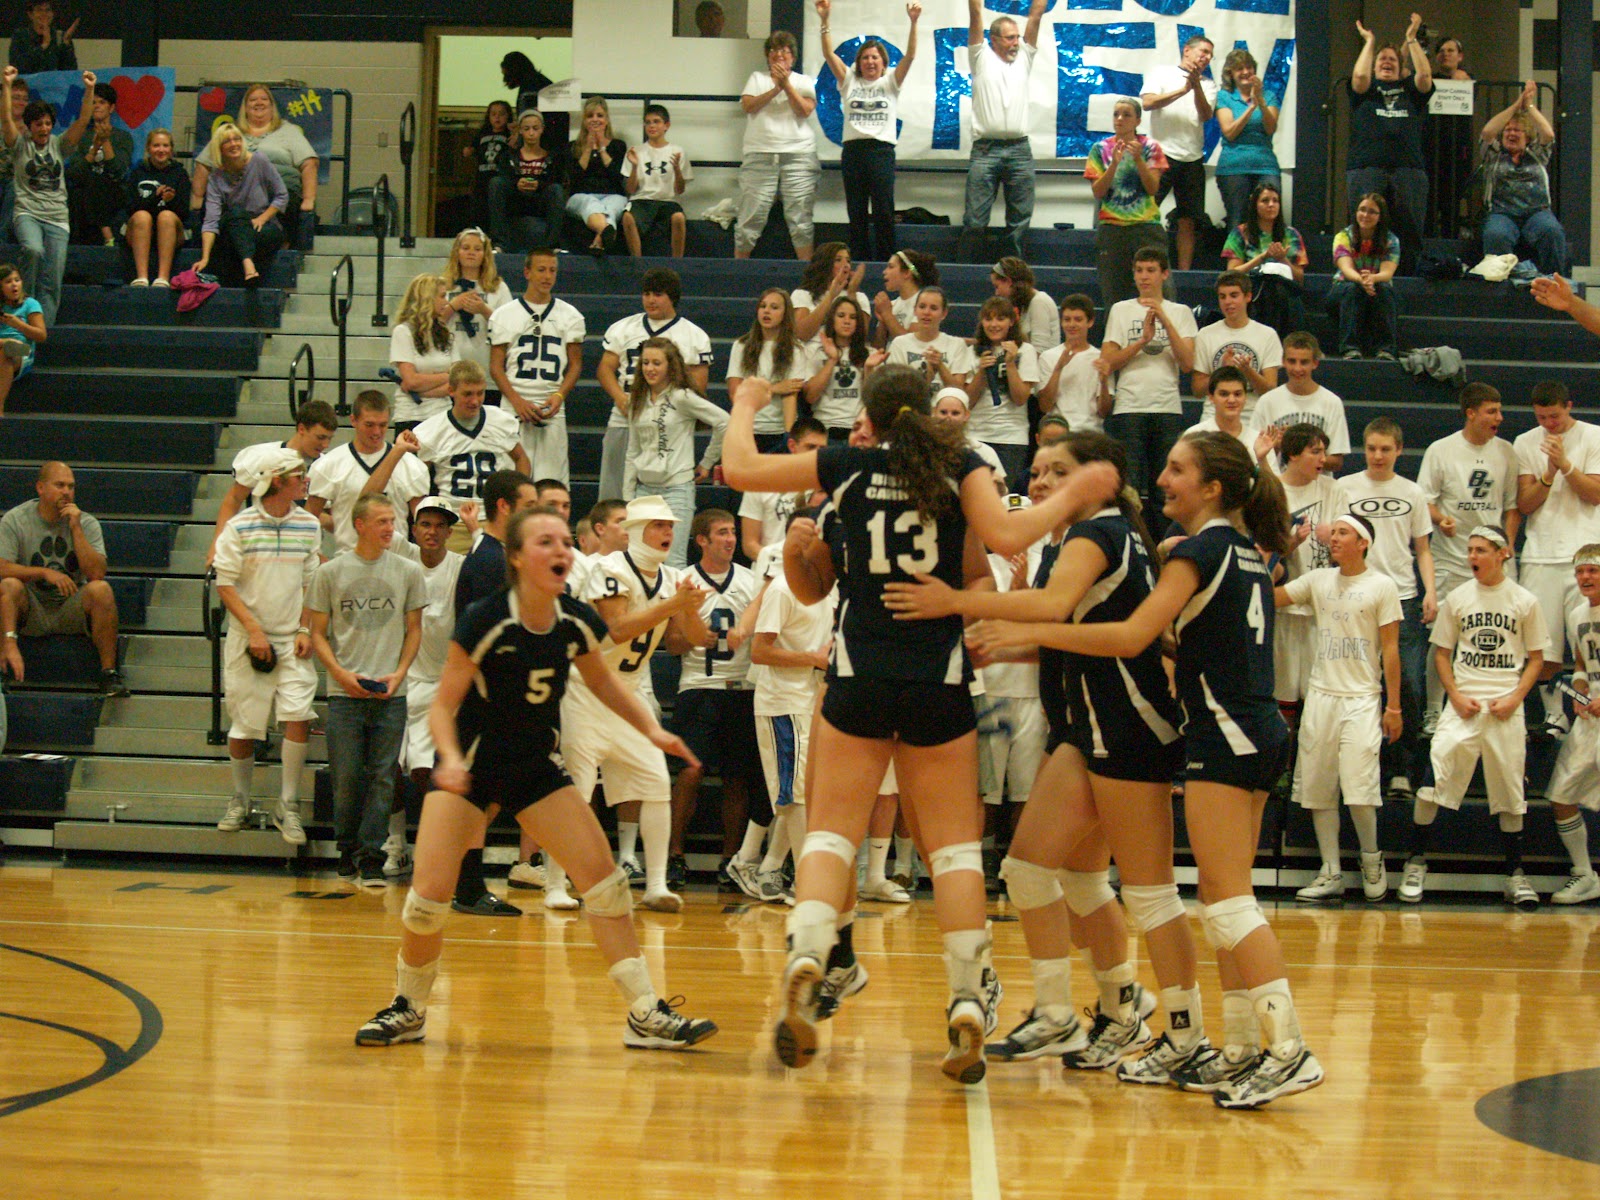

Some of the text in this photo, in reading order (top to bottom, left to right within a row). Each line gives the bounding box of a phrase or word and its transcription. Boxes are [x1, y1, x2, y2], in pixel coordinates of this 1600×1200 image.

[516, 334, 561, 381] 25
[450, 451, 497, 498] 28
[1360, 500, 1401, 512] OC
[866, 510, 939, 575] 13
[604, 577, 619, 598] 9
[1246, 583, 1265, 645] 4
[1477, 635, 1498, 646] XXL
[525, 668, 555, 704] 5
